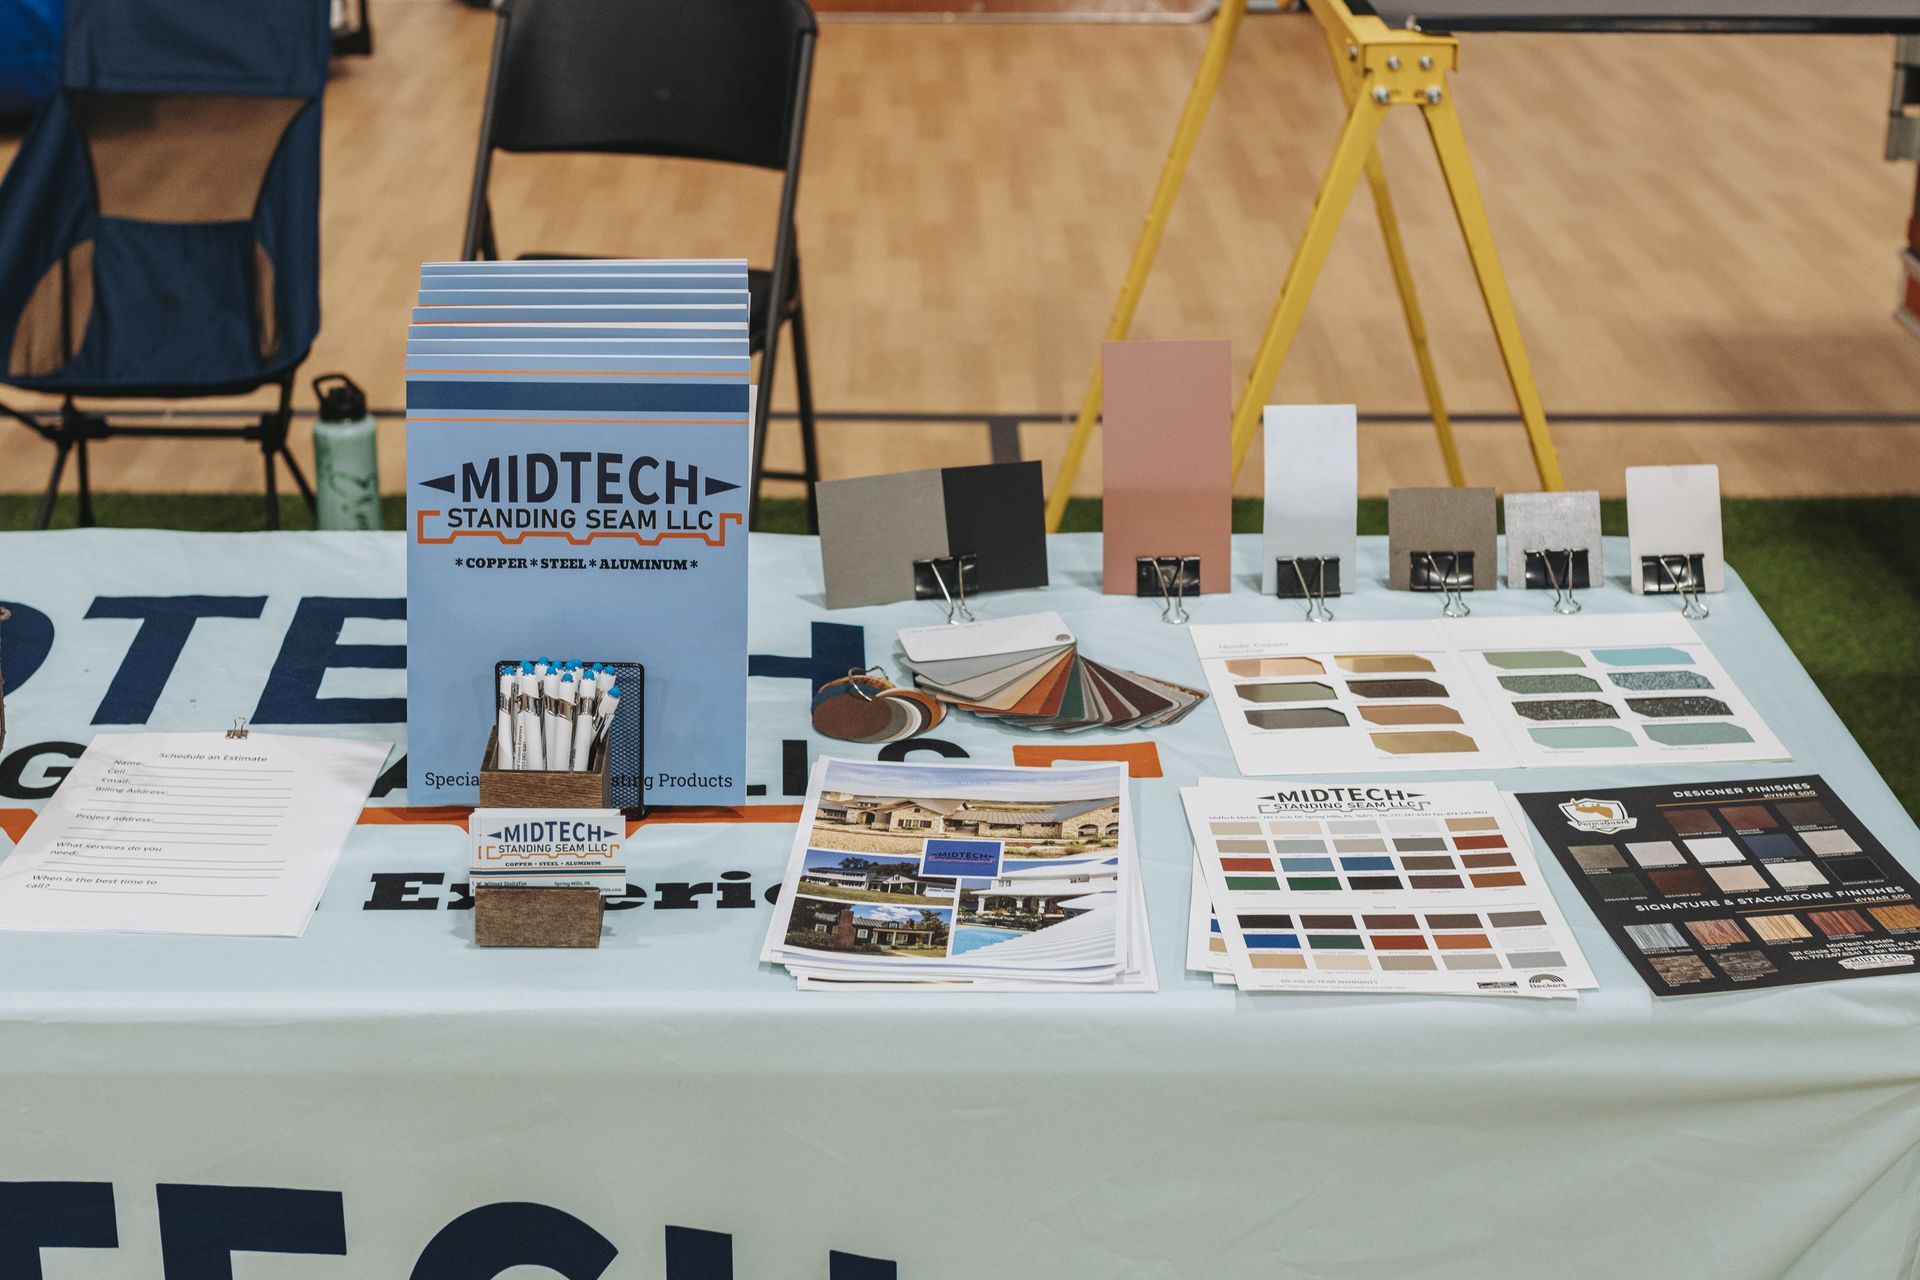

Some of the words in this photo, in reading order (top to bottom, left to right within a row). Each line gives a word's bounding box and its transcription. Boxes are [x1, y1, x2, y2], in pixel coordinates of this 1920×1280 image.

[462, 451, 698, 505] MIDTECH
[447, 508, 577, 529] STANDING
[586, 509, 657, 530] SEAM
[667, 510, 713, 531] LLC
[466, 557, 528, 570] COPPER
[540, 557, 587, 570] STEEL
[599, 558, 688, 571] ALUMINUM
[159, 752, 206, 761] Schedule
[224, 753, 268, 762] Estimate
[100, 777, 130, 785] Email:
[425, 771, 481, 788] Specia
[658, 772, 732, 788] Products
[95, 786, 124, 795] Billing
[125, 787, 168, 796] Address:
[1277, 788, 1405, 802] MIDTECH
[1673, 787, 1743, 799] DESIGNER
[1747, 782, 1811, 793] FINISHES
[1763, 791, 1795, 799] KYNAR
[1273, 802, 1343, 810] STANDING
[75, 813, 109, 823] Project
[111, 815, 153, 823] address:
[504, 821, 602, 843] MIDTECH
[50, 849, 78, 857] need:
[55, 841, 83, 849] What
[85, 843, 127, 851] services
[128, 844, 140, 852] do
[142, 846, 162, 854] you
[498, 843, 552, 854] STANDING
[555, 843, 586, 853] SEAM
[588, 843, 608, 853] LLC
[938, 851, 987, 859] MIDTECH
[32, 874, 59, 882] When
[63, 875, 72, 883] is
[76, 876, 94, 884] the
[96, 876, 118, 885] best
[120, 877, 143, 885] time
[146, 878, 157, 886] to
[25, 882, 50, 890] call?
[1635, 899, 1720, 913] SIGNATURE
[1724, 898, 1734, 906] &
[1738, 892, 1833, 906] STACKSTONE
[1837, 886, 1905, 898] FINISHES
[1855, 895, 1889, 903] KYNAR
[1826, 940, 1863, 949] MidTech
[1864, 938, 1895, 946] Metals
[1803, 948, 1829, 956] Circle
[1845, 944, 1874, 953] Spring
